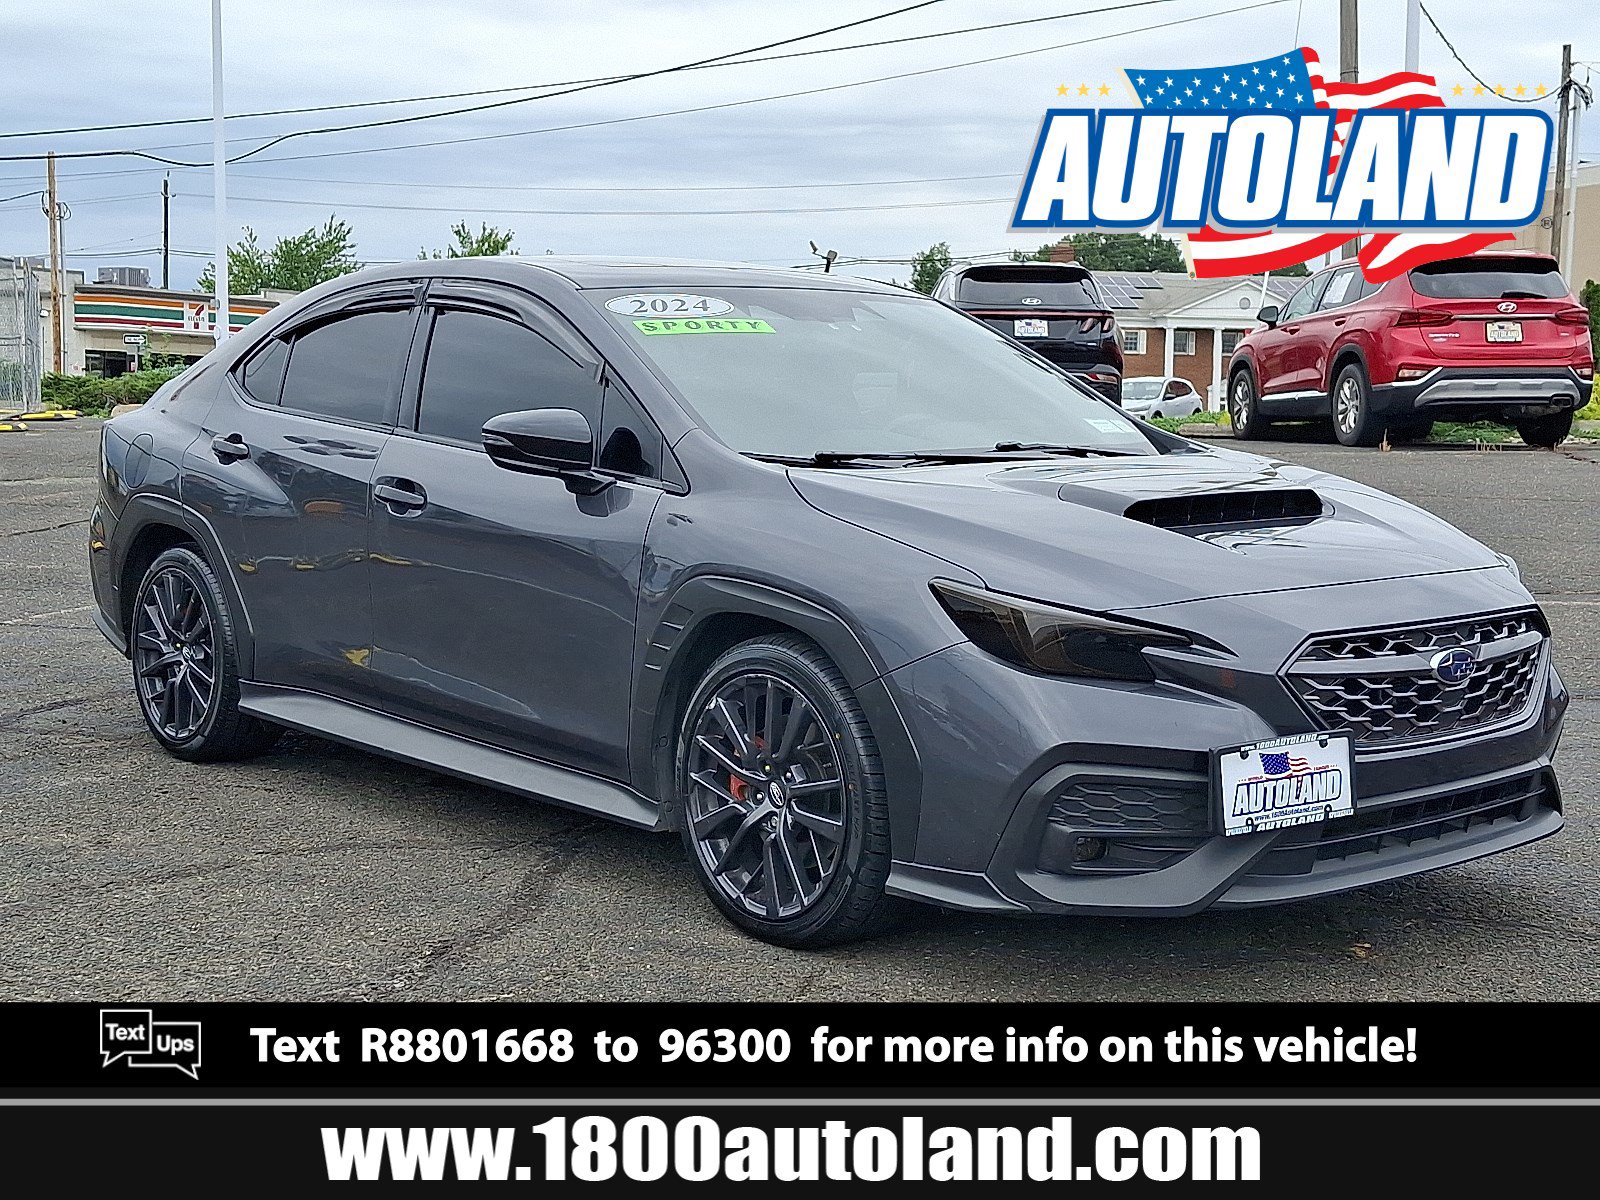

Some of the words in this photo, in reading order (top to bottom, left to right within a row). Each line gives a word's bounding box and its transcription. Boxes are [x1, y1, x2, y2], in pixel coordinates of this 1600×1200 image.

[630, 298, 711, 314] 2024
[641, 320, 763, 332] SPORTY
[1232, 769, 1342, 817] AUTOLAND
[1256, 813, 1324, 832] AUTOLAND
